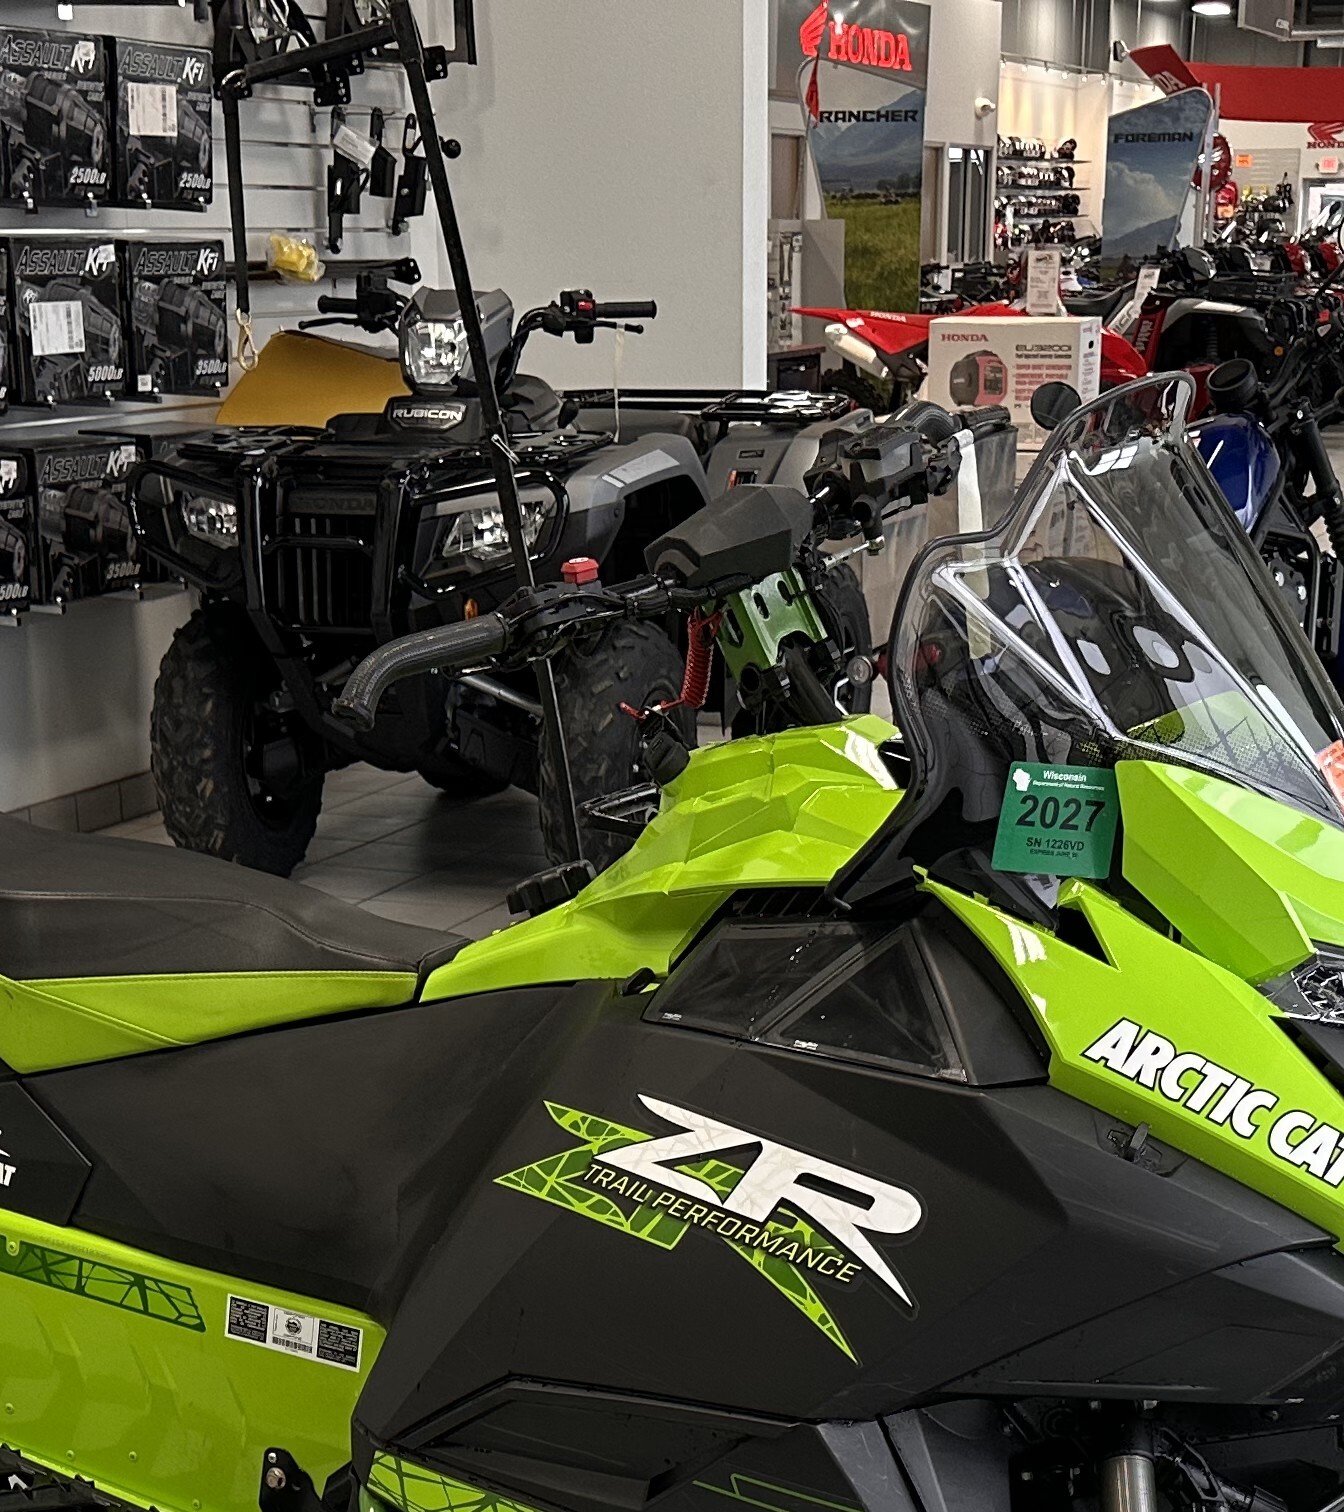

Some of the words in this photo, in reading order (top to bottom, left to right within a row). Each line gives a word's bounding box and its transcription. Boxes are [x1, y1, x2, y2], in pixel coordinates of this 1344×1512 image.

[828, 20, 913, 71] HONDA
[118, 46, 183, 81] ASSAULT
[819, 110, 919, 123] RANCHER
[1114, 131, 1194, 144] FOREMAN
[70, 166, 107, 185] 2500LB
[16, 246, 87, 276] ASSAULT
[133, 247, 198, 276] ASSAULT
[196, 248, 220, 276] KFi
[870, 311, 907, 323] HONDA
[940, 333, 990, 343] HONDA
[87, 365, 124, 383] 5000LB
[393, 409, 463, 421] RUBICON
[39, 454, 107, 483] ASSAULT
[1043, 770, 1087, 782] Wisconsin
[1015, 794, 1106, 832] 2027
[1026, 837, 1041, 848] SN
[1046, 838, 1085, 852] 1226VD
[1080, 1017, 1280, 1139] ARCTIC
[594, 1093, 923, 1308] ZR
[584, 1163, 651, 1202] TRAIL
[651, 1190, 862, 1284] PERFORMANCE
